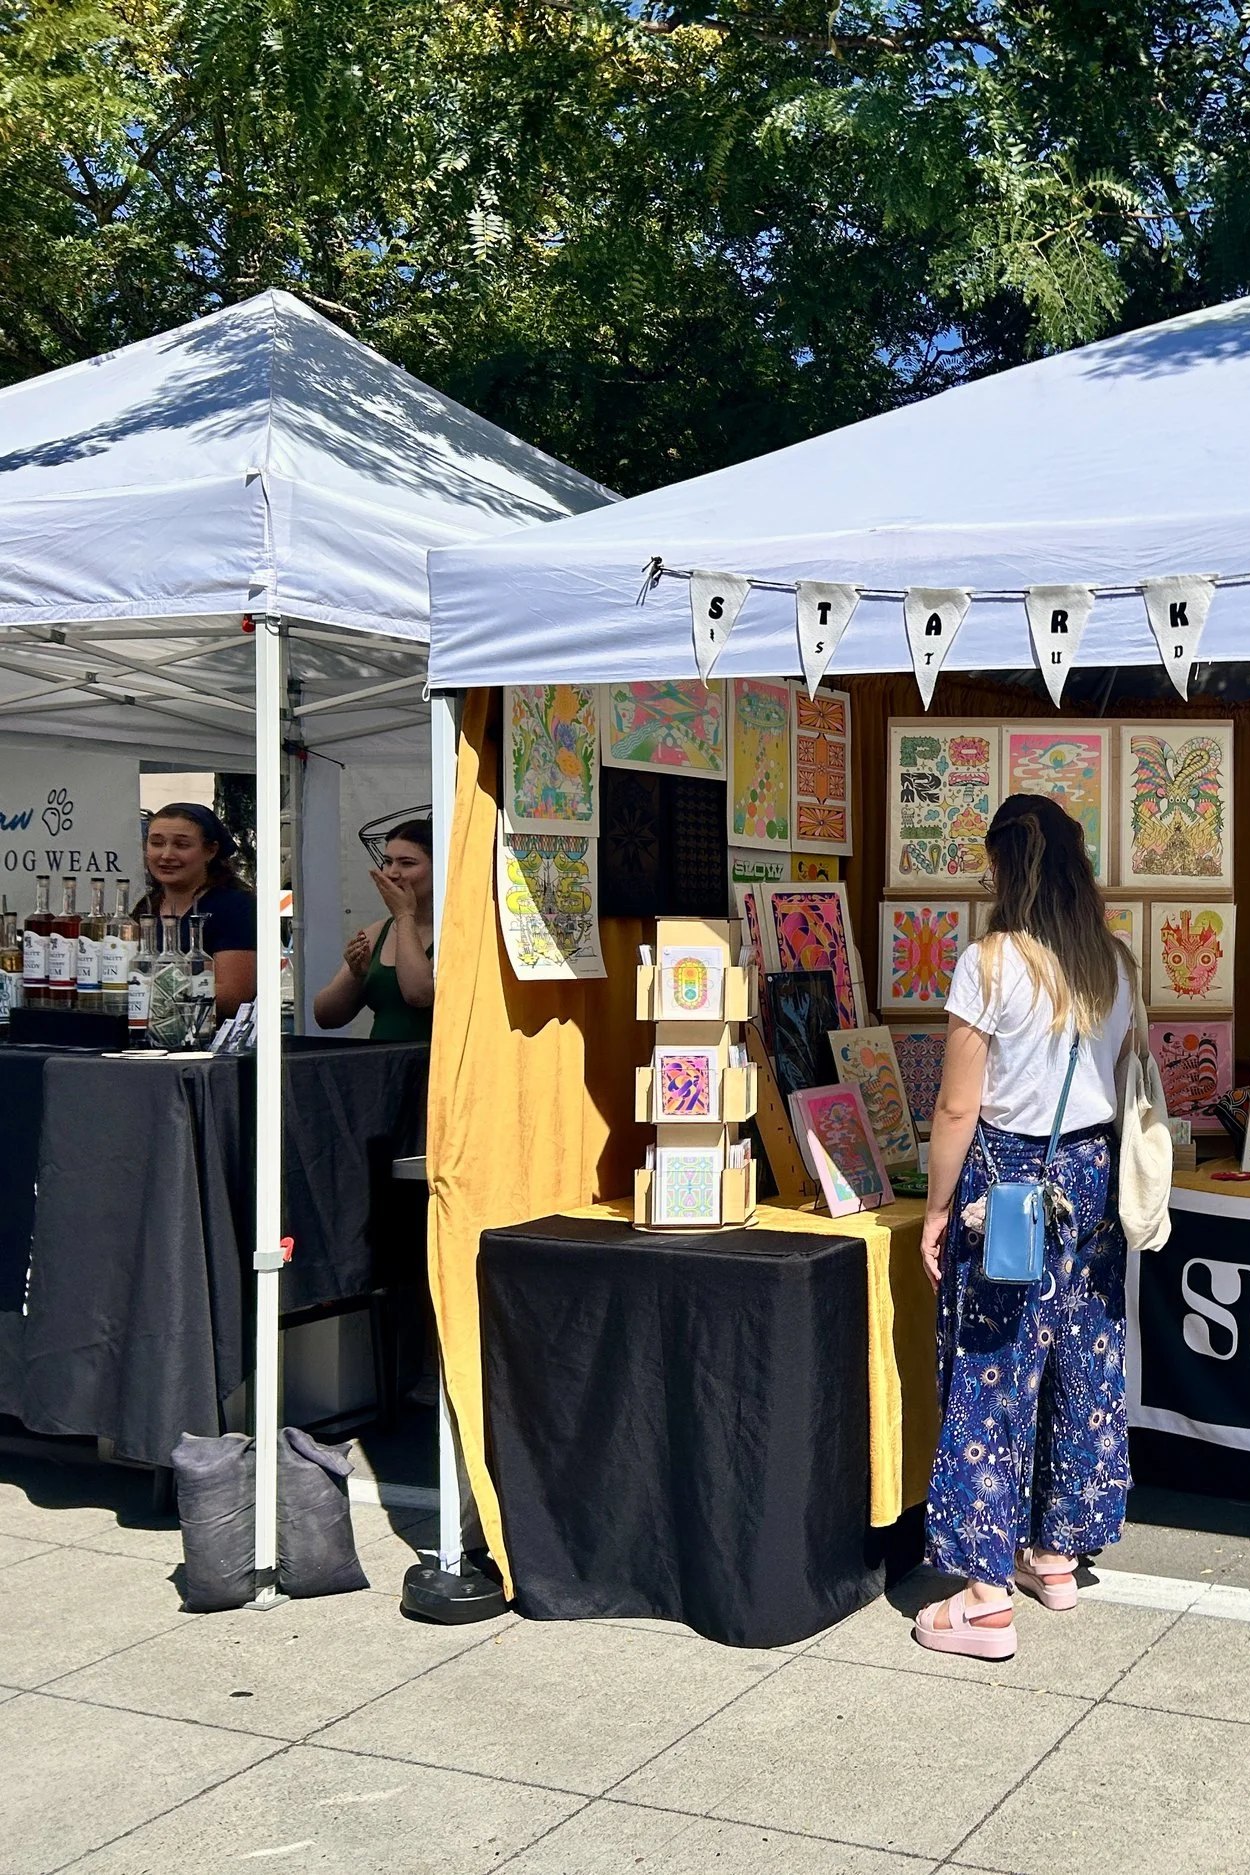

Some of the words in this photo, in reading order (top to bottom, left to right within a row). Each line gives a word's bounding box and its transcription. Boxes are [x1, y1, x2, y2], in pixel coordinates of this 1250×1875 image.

[4, 850, 36, 871] OG
[45, 850, 122, 872] WEAR
[733, 860, 784, 878] SLOW
